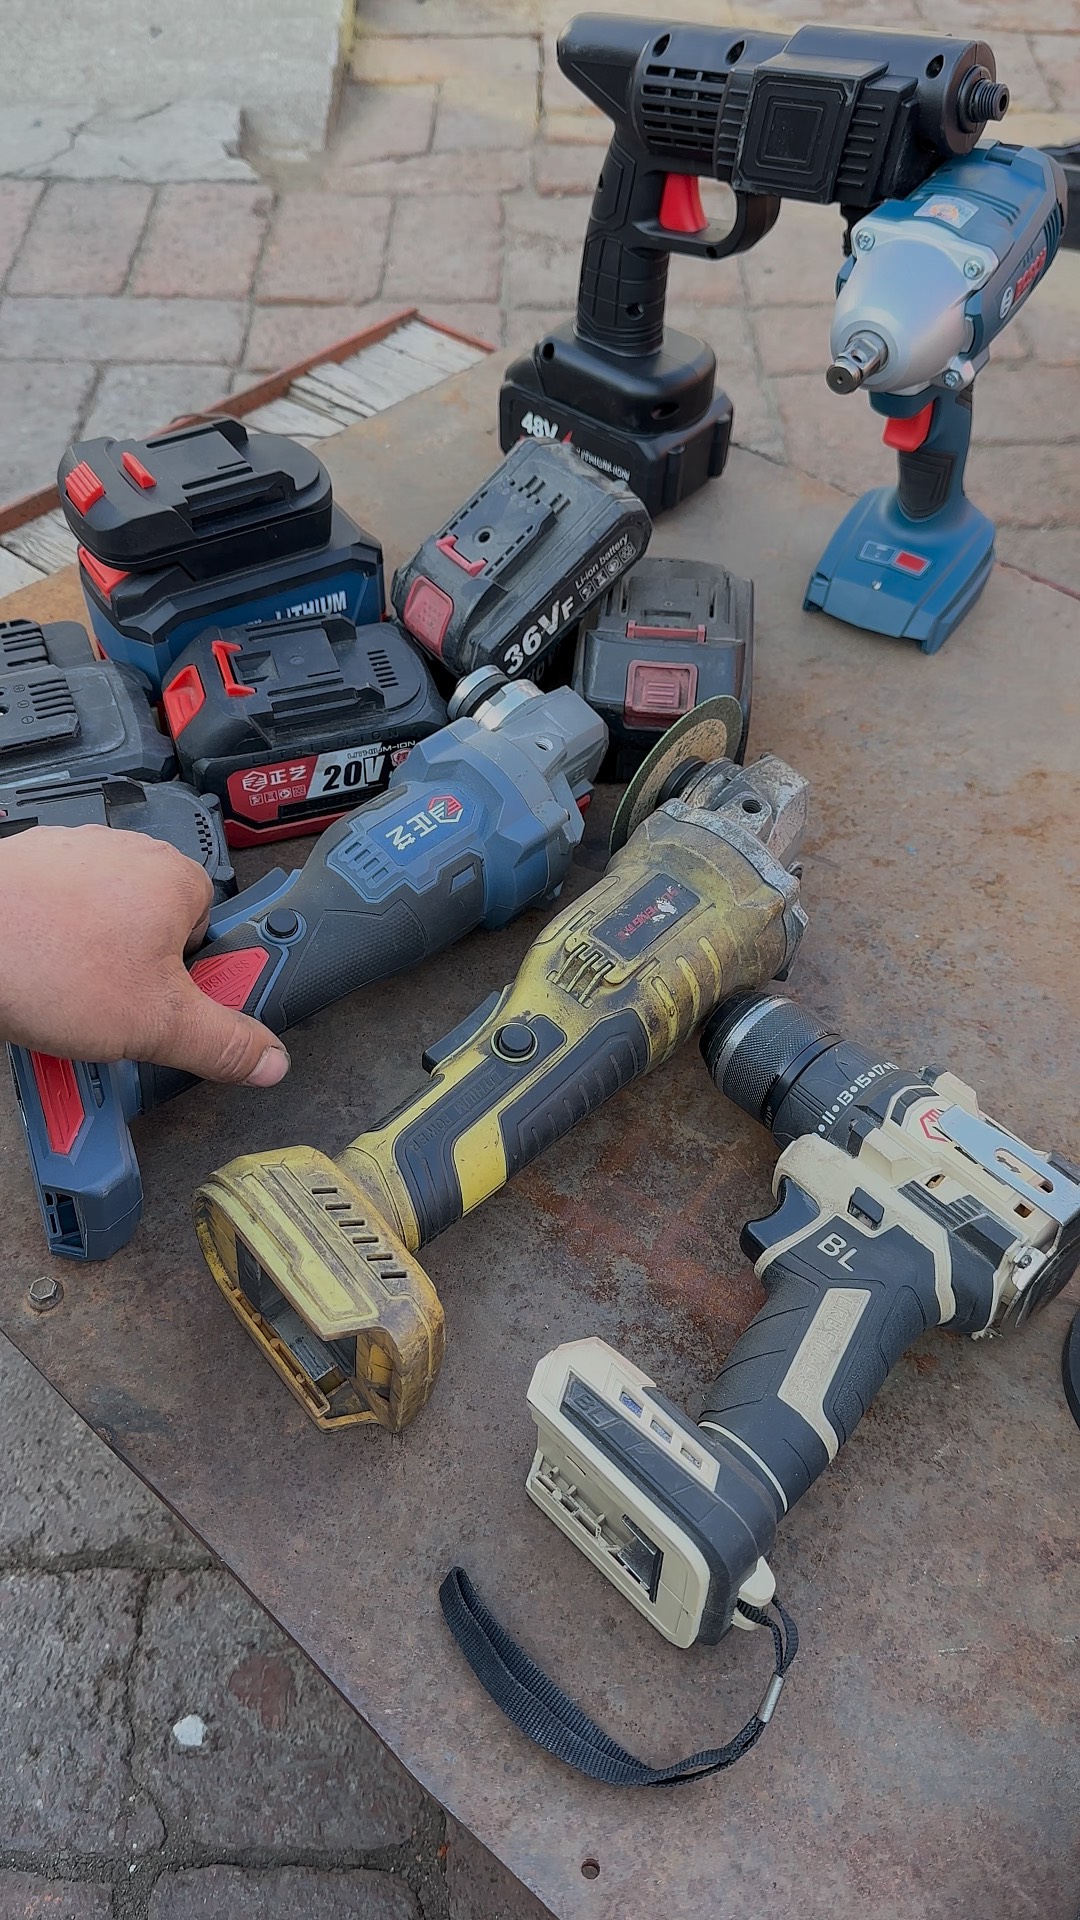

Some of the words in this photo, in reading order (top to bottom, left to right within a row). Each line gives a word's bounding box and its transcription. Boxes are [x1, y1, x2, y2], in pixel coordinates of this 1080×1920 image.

[521, 410, 558, 439] 48V
[599, 533, 629, 566] battery
[269, 764, 308, 786] 正艺
[321, 755, 386, 793] 20V
[200, 959, 250, 995] RUSHLESS
[836, 1090, 854, 1106] 13
[854, 1073, 873, 1089] 15
[817, 1232, 858, 1272] BL
[573, 1394, 601, 1425] BL
